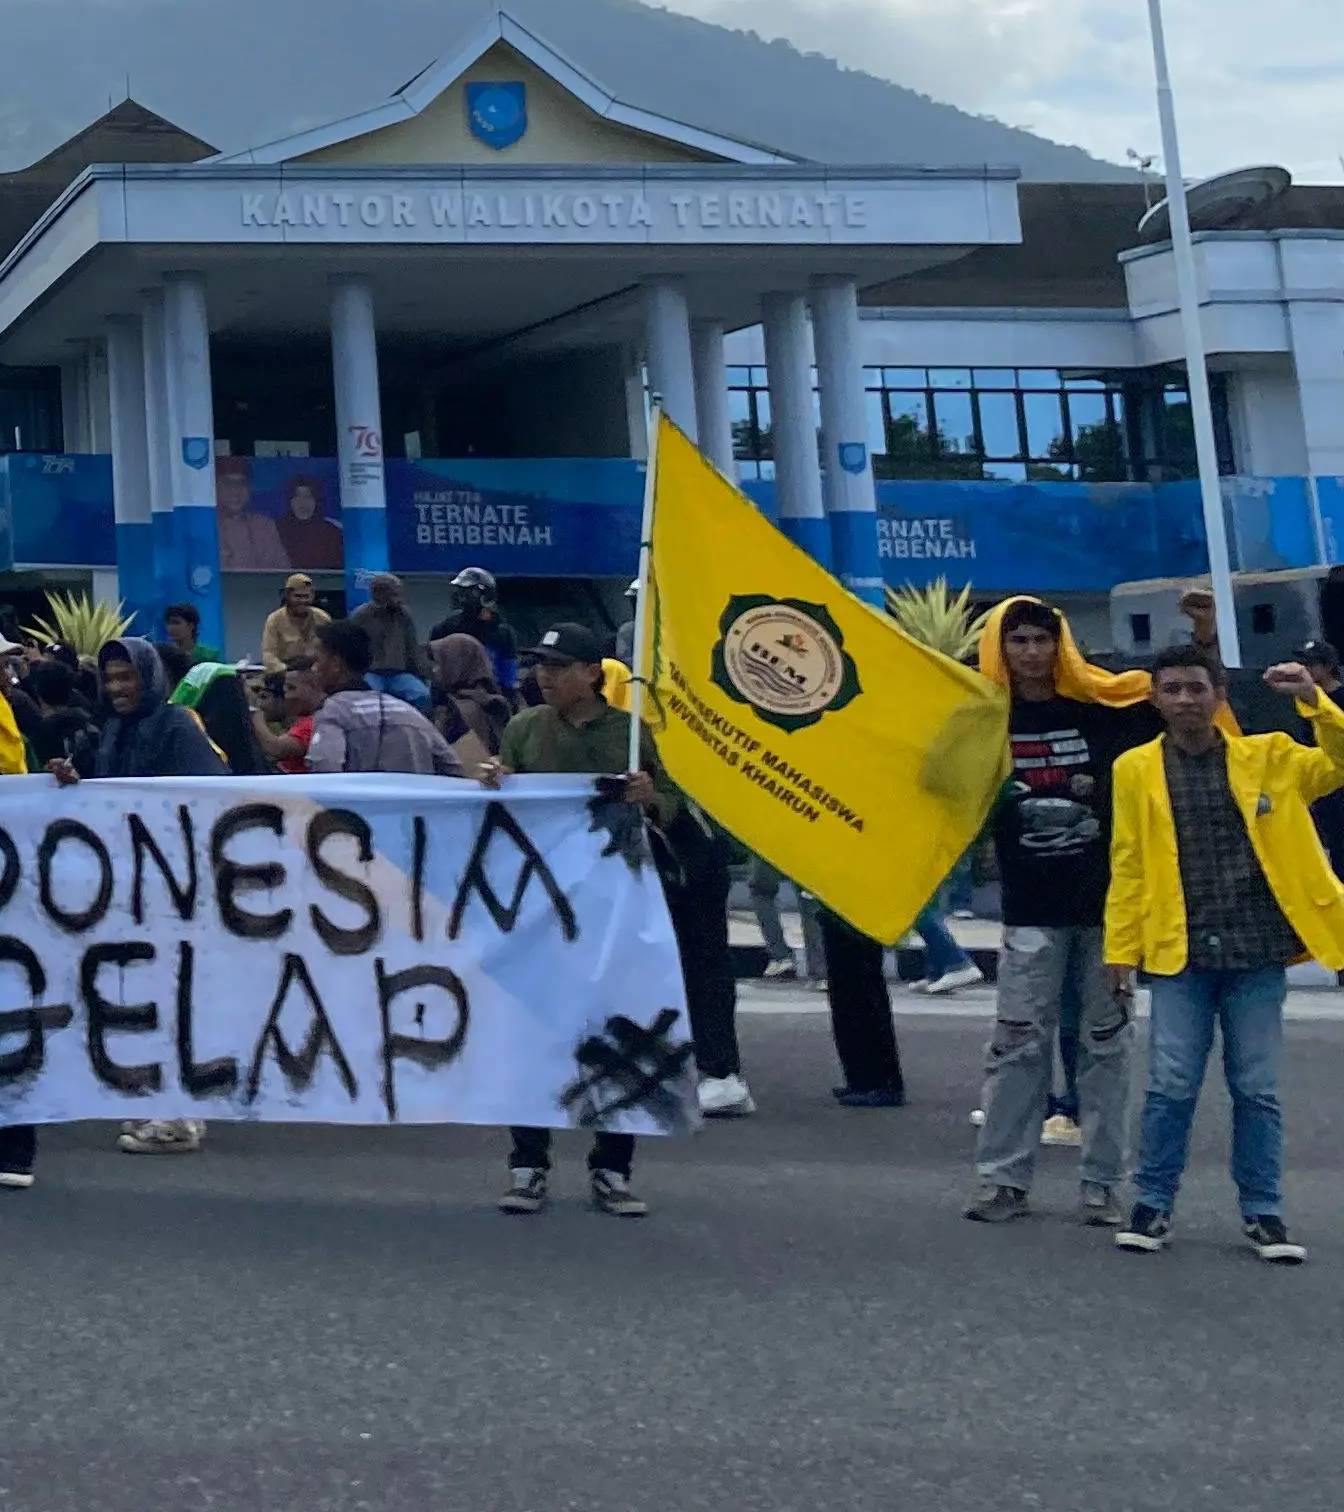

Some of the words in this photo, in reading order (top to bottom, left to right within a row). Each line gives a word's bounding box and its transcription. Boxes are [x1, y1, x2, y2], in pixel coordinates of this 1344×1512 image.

[240, 193, 417, 228] KANTOR
[430, 193, 656, 228] WALIKOTA
[669, 193, 867, 228] TERNATE
[414, 504, 529, 525] TERNATE
[416, 524, 553, 546] BERBENAH
[877, 518, 954, 539] RNATE
[878, 538, 978, 559] RBENAH
[742, 760, 821, 824] KHAIRUN
[761, 750, 865, 834] MAHASISWA
